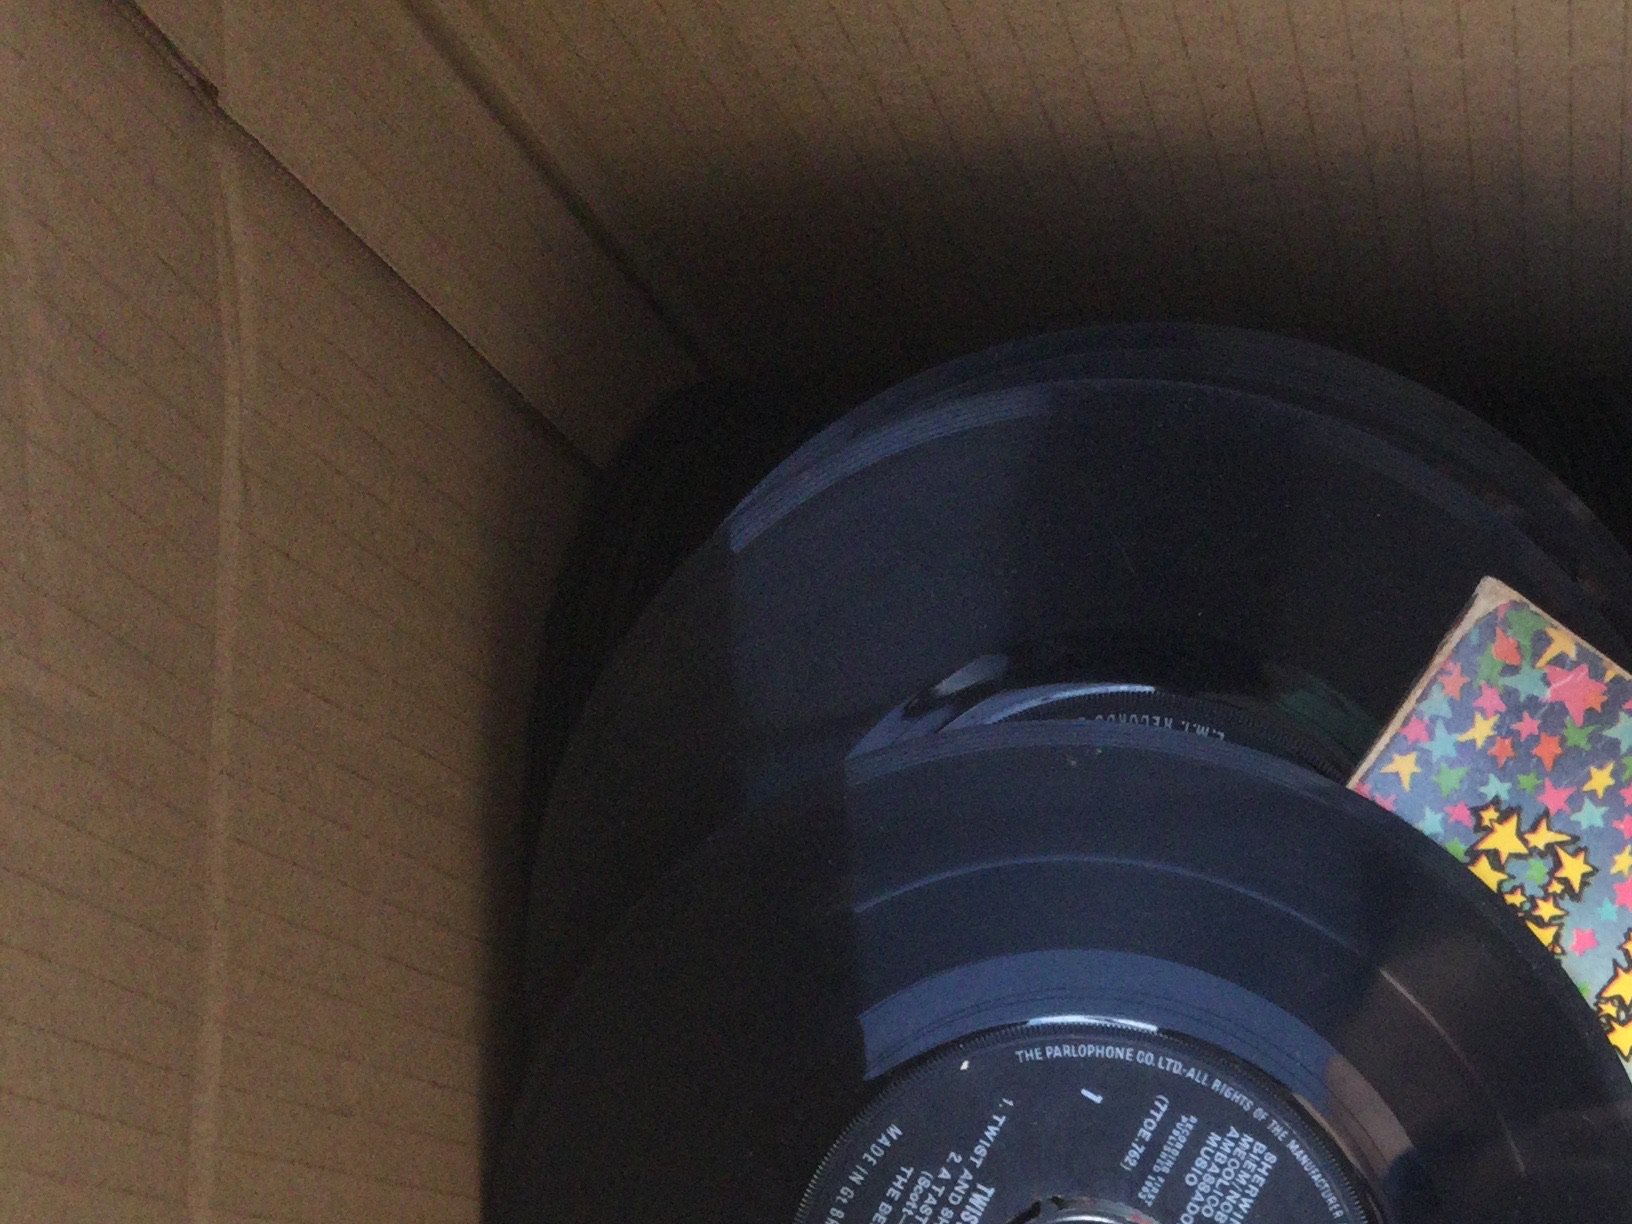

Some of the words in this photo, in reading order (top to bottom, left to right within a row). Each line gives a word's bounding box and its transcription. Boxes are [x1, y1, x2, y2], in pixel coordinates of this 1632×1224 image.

[1080, 1088, 1104, 1104] 1
[861, 1123, 903, 1166] MADE
[969, 1114, 1007, 1168] TWIST
[1014, 1047, 1044, 1063] THE
[1045, 1043, 1134, 1062] PARLOPHONE
[1211, 1078, 1254, 1112] RIGHTS
[1252, 1106, 1269, 1122] OF
[1267, 1118, 1289, 1142] THE
[1285, 1138, 1344, 1219] MANUFACTURER
[848, 1164, 869, 1186] IN
[885, 1166, 915, 1201] THE
[937, 1166, 952, 1180] A
[948, 1167, 974, 1206] AND
